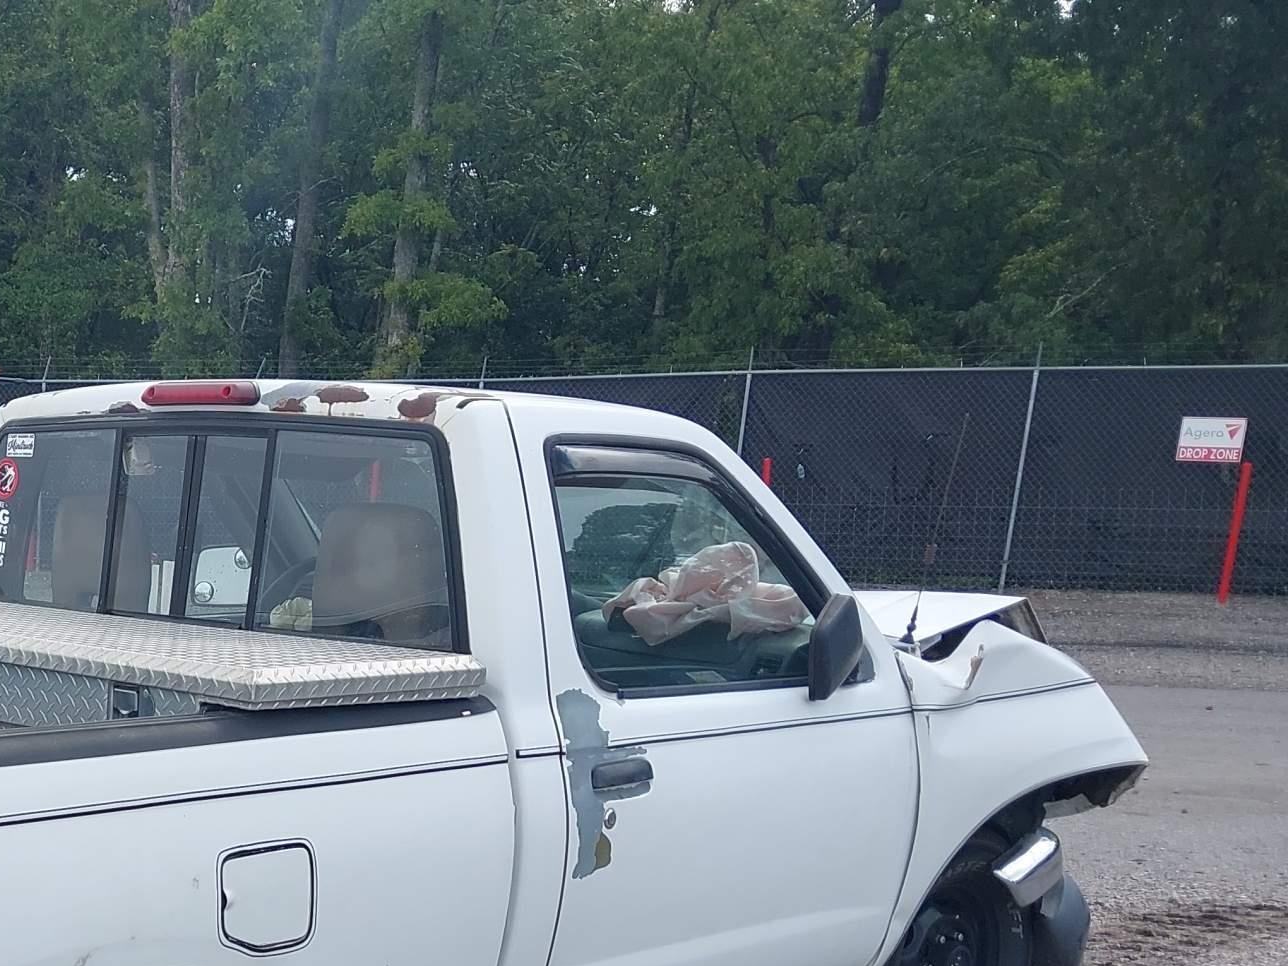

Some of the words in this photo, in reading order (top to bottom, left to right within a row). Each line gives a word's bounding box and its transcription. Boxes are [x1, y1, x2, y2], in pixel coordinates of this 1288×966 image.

[1184, 427, 1224, 440] Agero
[1179, 448, 1208, 458] DROP
[1210, 449, 1239, 460] ZONE
